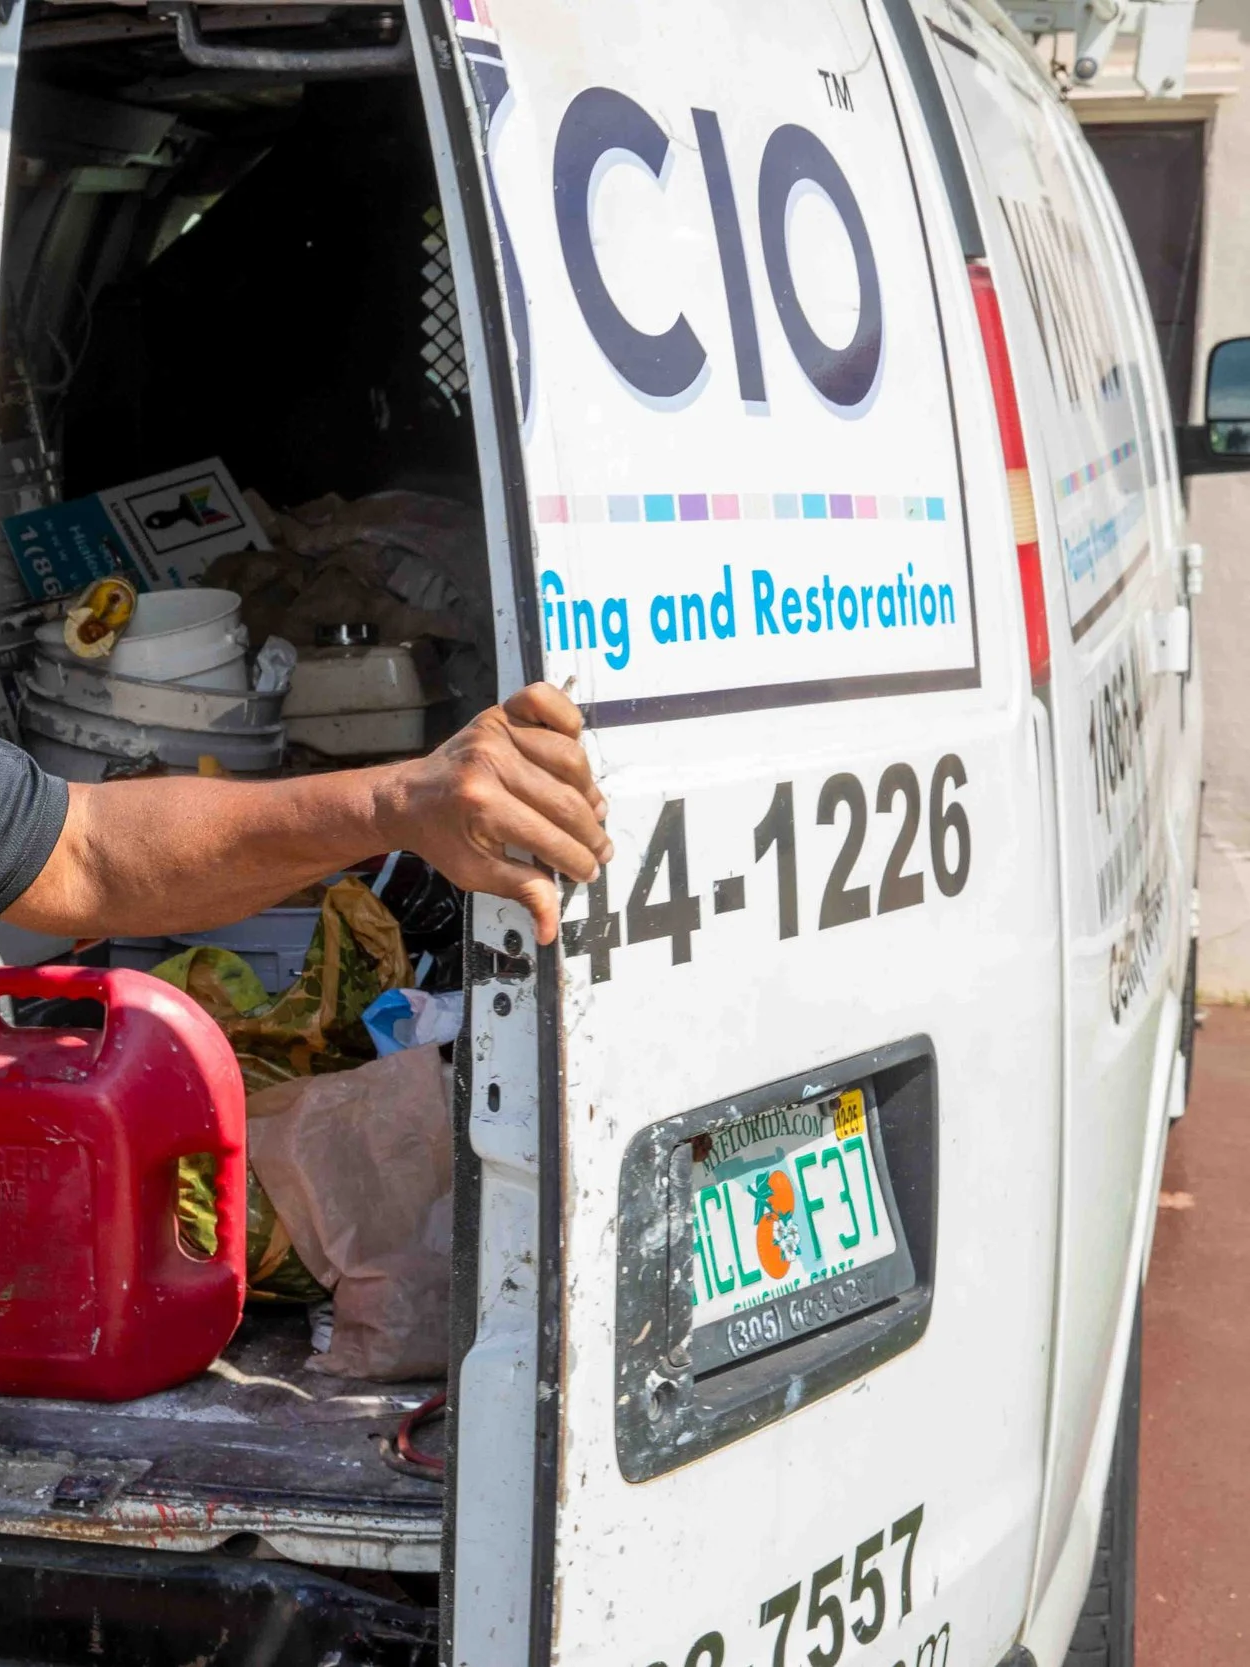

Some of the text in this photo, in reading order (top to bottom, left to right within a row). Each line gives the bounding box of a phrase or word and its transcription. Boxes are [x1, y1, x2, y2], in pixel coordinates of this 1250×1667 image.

[817, 69, 855, 113] TM
[650, 565, 735, 648] and
[751, 562, 956, 636] Restoration
[795, 1136, 879, 1260] F37
